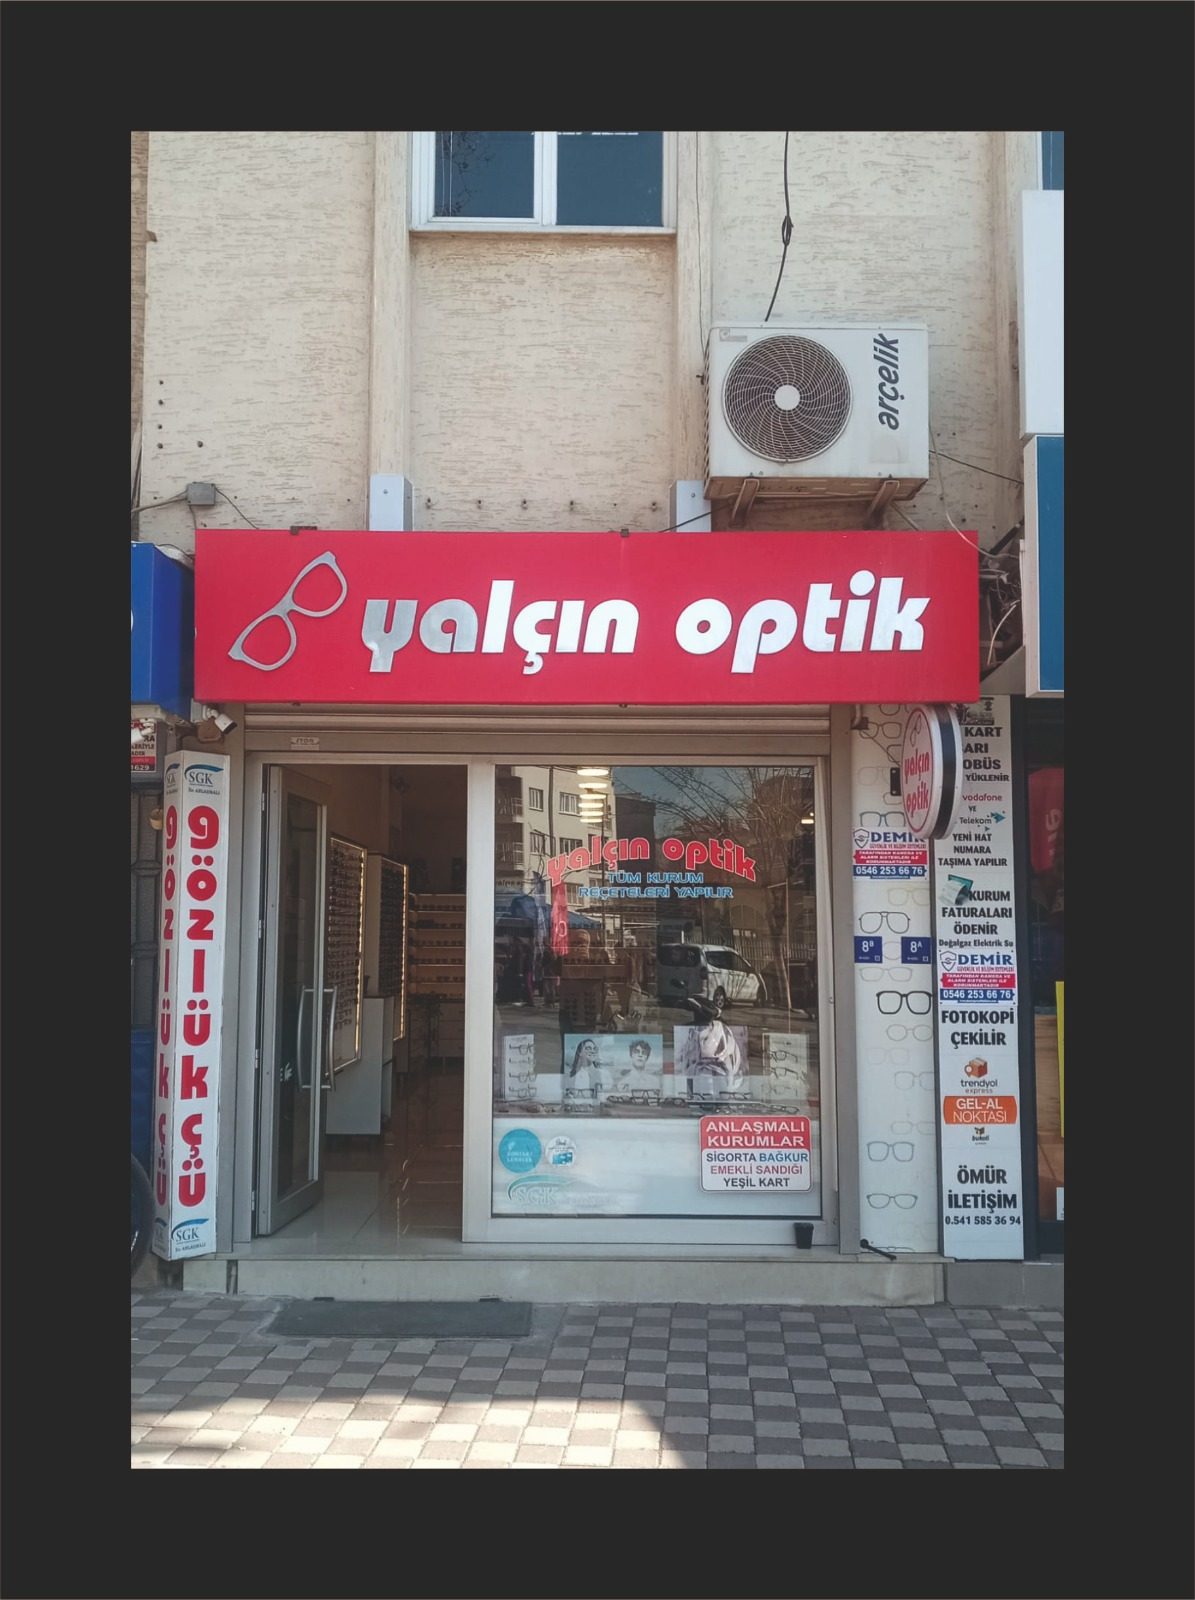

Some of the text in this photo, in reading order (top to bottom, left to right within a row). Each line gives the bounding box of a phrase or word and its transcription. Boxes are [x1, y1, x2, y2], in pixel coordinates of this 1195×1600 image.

[873, 333, 905, 430] arçelik
[361, 569, 931, 675] yalçın optik
[964, 726, 1003, 737] KART
[963, 742, 989, 753] ARI
[904, 747, 930, 784] yalçın
[188, 771, 213, 785] SGK
[965, 773, 1010, 782] YÜKLENİR
[906, 781, 929, 818] optik
[962, 793, 1003, 801] vodafone
[952, 831, 992, 841] YENİ HAT
[953, 846, 992, 854] NUMARA
[546, 835, 756, 887] yalçın optik
[938, 858, 1008, 869] TAŞIMA YAPILIR
[608, 870, 704, 883] TÜM KURUM
[856, 866, 923, 875] 0546 253 66 76
[578, 884, 734, 899] REÇETELERİ YAPILIR
[968, 891, 1011, 901] KURUM
[942, 907, 1013, 918] FATURALARI
[954, 921, 998, 935] ÖDENİR
[938, 939, 1014, 948] Doğalgaz Elektrik Su
[958, 951, 1014, 965] DEMİR
[943, 990, 1011, 998] 0546 253 66 76
[178, 805, 219, 1207] gözlükçü
[941, 1007, 1015, 1024] FOTOKOPİ
[950, 1029, 1007, 1049] ÇEKİLİR
[960, 1079, 998, 1088] trendyol
[956, 1098, 1003, 1110] GEL-AL
[953, 1110, 1007, 1123] NOKTASI
[706, 1121, 805, 1134] ANLAŞMALI
[708, 1136, 804, 1146] KURUMLAR
[706, 1151, 809, 1162] SİGORTA BAĞKUR
[710, 1164, 803, 1175] EMEKLİ SANDIĞI
[957, 1165, 1008, 1184] ÖMÜR
[723, 1176, 790, 1188] YEŞİL KART
[948, 1189, 1018, 1214] İLETİŞİM
[945, 1216, 1021, 1225] 0.541 585 36 94
[176, 1227, 200, 1241] SGK
